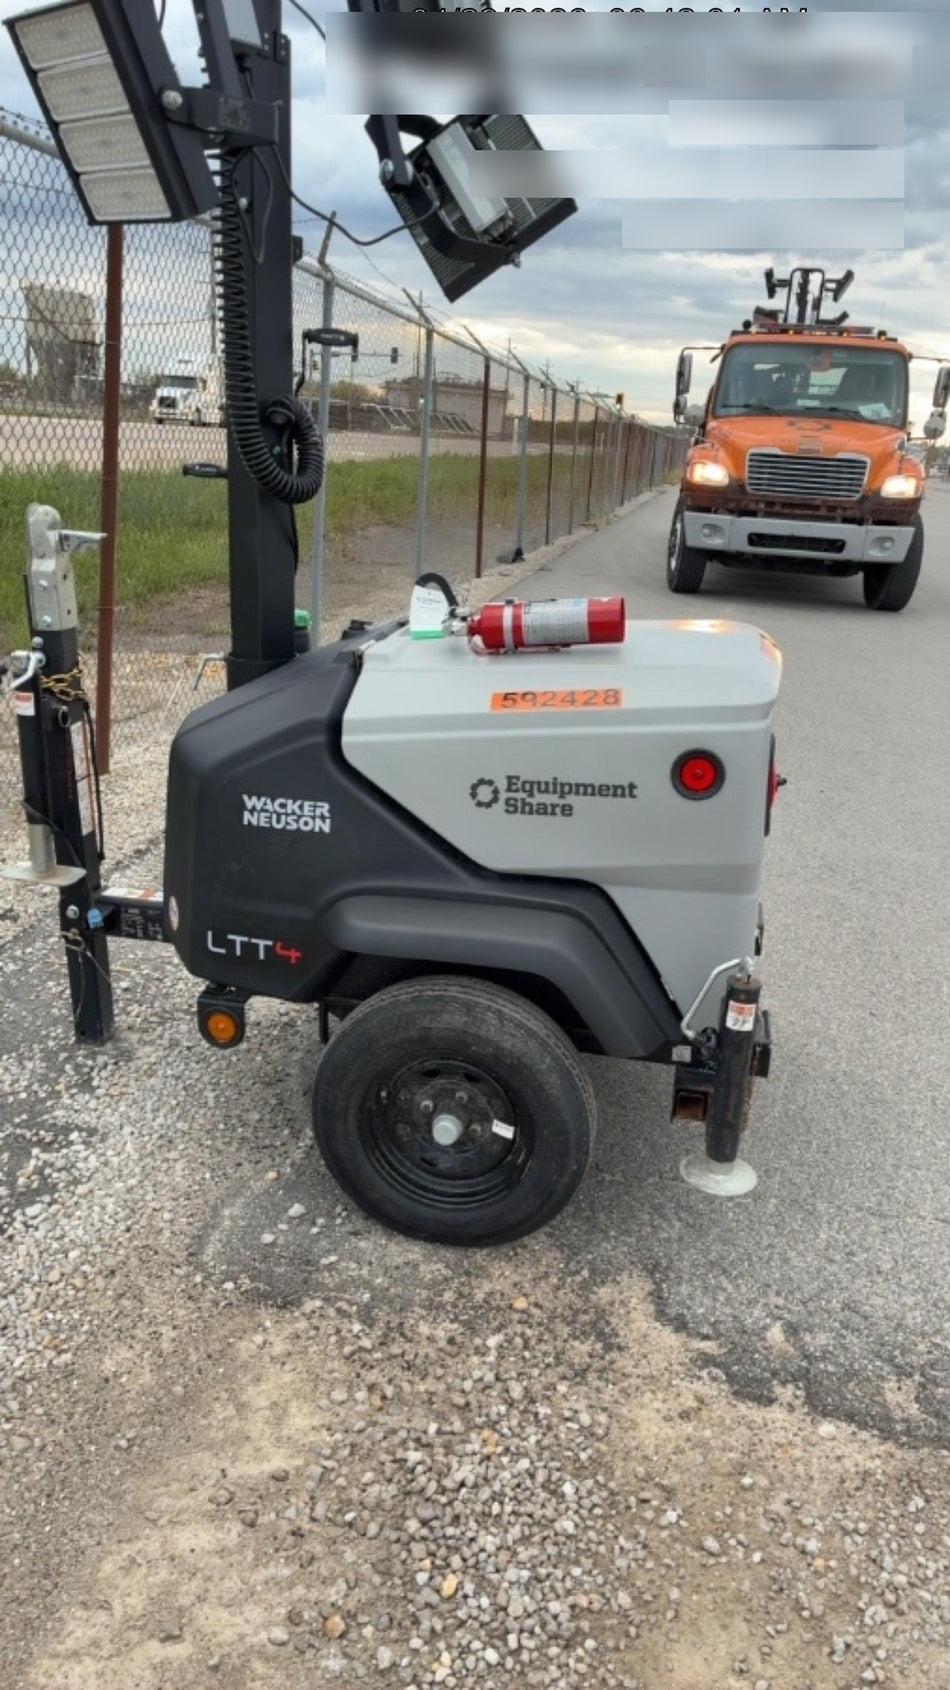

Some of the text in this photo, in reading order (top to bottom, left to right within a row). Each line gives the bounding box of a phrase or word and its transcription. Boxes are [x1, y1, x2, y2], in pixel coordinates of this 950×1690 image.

[501, 688, 620, 708] 592428
[505, 775, 638, 799] Equipment
[242, 794, 331, 817] WACKER
[504, 797, 574, 817] Share
[242, 810, 331, 833] NEUSON
[207, 930, 302, 964] LTT4
